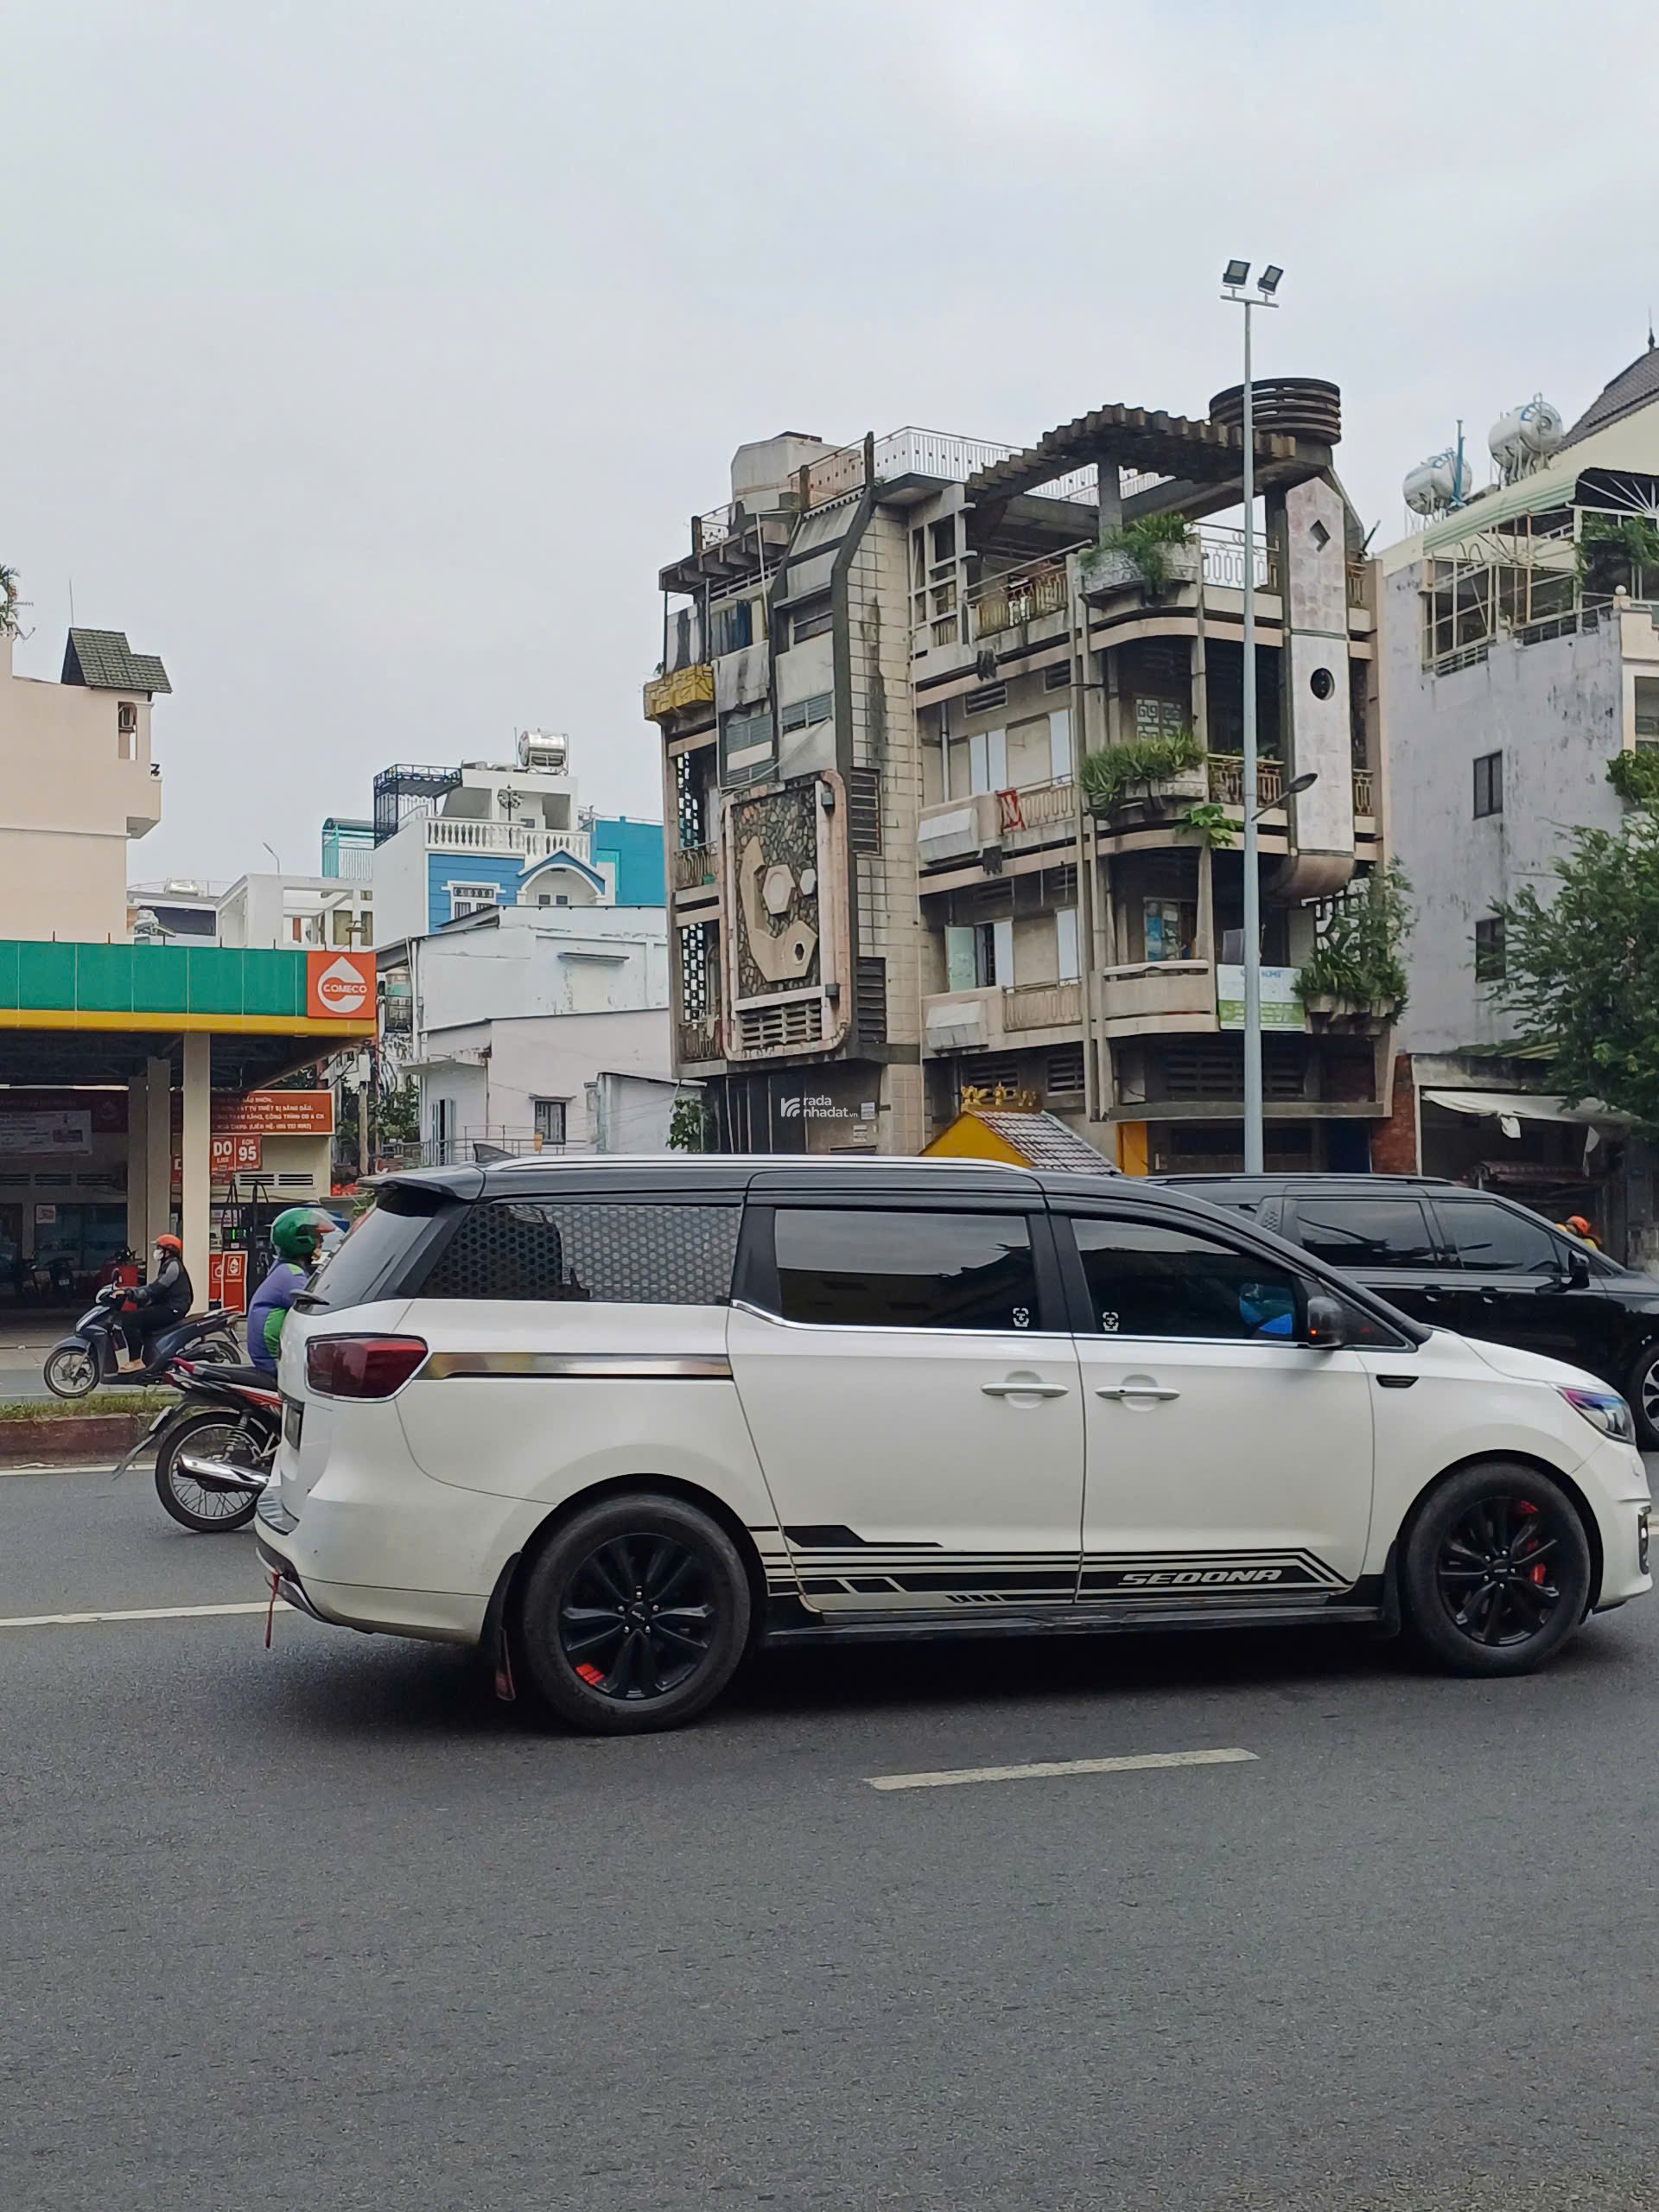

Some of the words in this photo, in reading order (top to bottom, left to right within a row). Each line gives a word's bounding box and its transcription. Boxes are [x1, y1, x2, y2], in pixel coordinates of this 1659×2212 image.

[323, 984, 367, 994] COMECO
[213, 1141, 232, 1157] DO
[238, 1145, 257, 1162] 95
[1118, 1569, 1283, 1586] SEDONA
